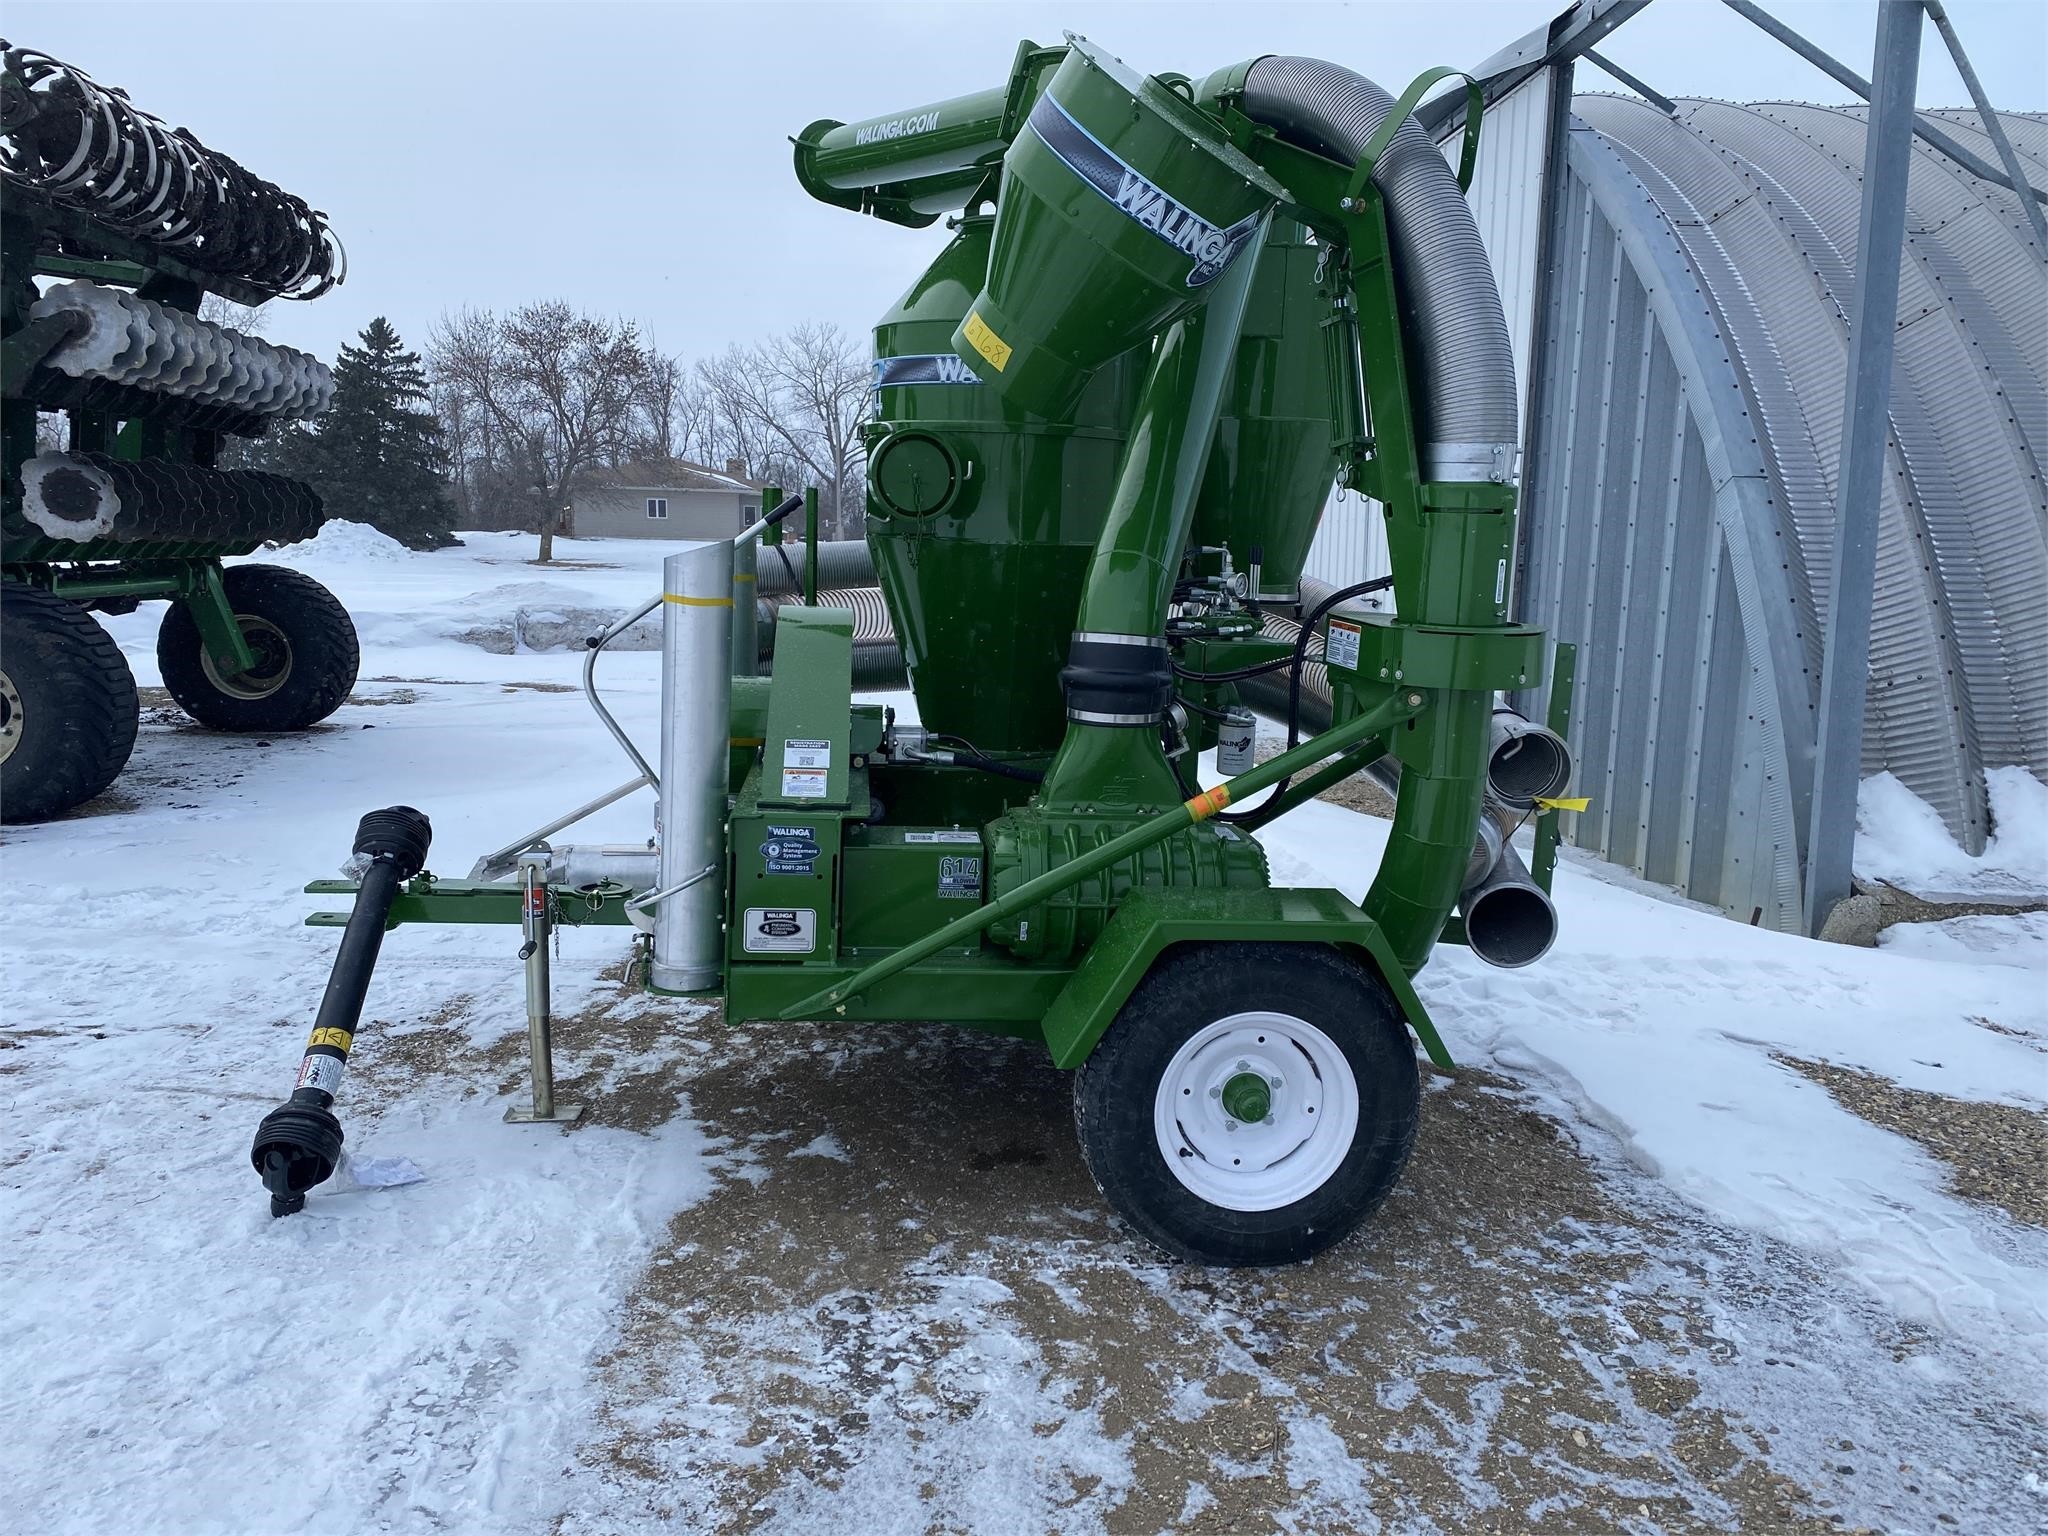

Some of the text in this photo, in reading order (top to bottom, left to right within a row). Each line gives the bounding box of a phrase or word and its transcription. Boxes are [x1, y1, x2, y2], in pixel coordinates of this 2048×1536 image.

[855, 111, 940, 145] WALINGA.COM
[1115, 169, 1235, 269] WALINGA
[772, 828, 810, 836] WALINGA
[940, 857, 979, 879] 614
[939, 890, 979, 898] WALINGA
